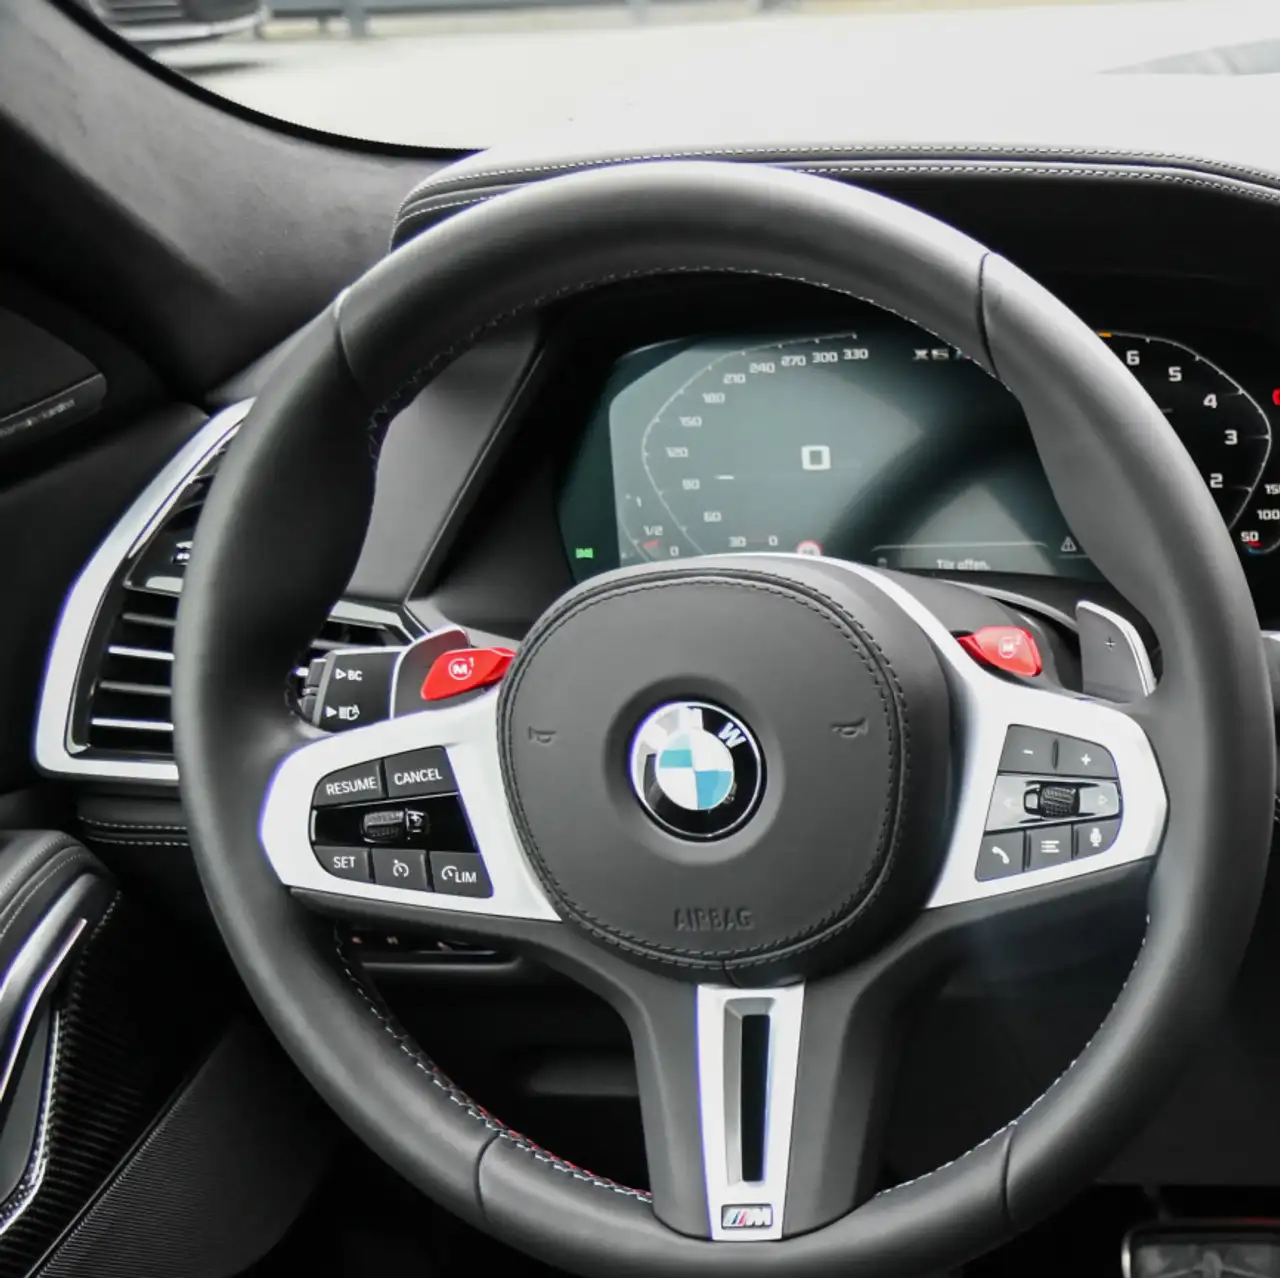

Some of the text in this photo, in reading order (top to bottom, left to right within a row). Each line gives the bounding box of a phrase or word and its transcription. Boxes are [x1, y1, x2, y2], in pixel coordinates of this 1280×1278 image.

[781, 354, 806, 367] 270
[812, 351, 838, 363] 300
[843, 348, 869, 361] 330
[1126, 350, 1140, 365] 6
[749, 361, 775, 374] 240
[723, 373, 746, 385] 210
[1168, 367, 1182, 382] 5
[702, 392, 725, 404] 180
[1204, 394, 1218, 409] 4
[680, 415, 702, 427] 150
[1225, 430, 1238, 445] 3
[665, 446, 689, 459] 120
[801, 445, 831, 470] 0
[1210, 473, 1223, 488] 2
[703, 511, 722, 523] 60
[1257, 509, 1280, 521] 100
[728, 536, 746, 548] 30
[768, 535, 779, 546] 0
[1241, 531, 1259, 542] 50
[669, 546, 680, 557] 0
[347, 669, 363, 681] BC
[394, 767, 442, 787] CANCEL
[326, 776, 377, 796] RESUME
[333, 856, 356, 869] SET
[454, 871, 477, 884] LIM
[674, 908, 754, 931] AIRBAG
